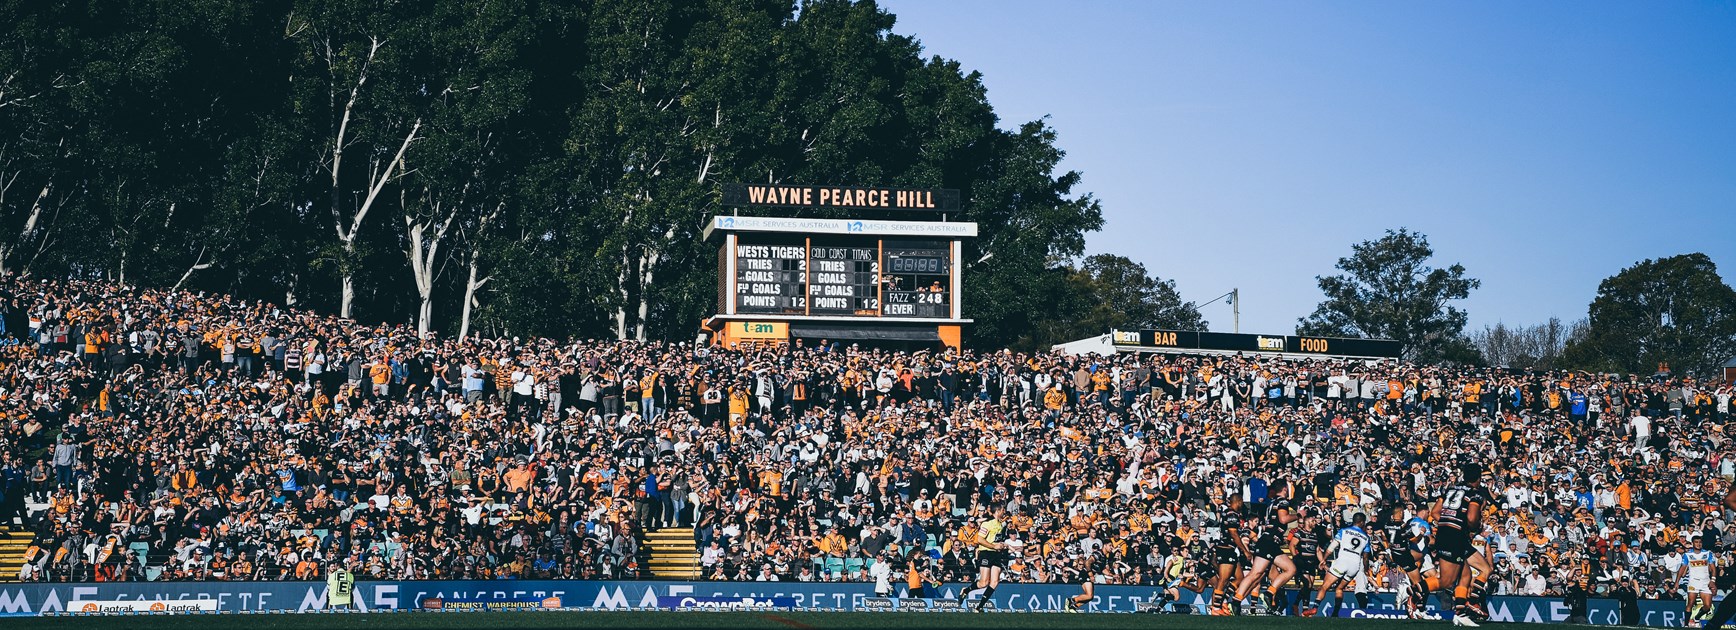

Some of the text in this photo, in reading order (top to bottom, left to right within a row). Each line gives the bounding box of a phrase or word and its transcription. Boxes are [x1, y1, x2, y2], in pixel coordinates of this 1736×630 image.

[749, 186, 935, 208] WAYNE PEARCE HILL
[737, 245, 805, 259] WESTS TIGERS
[829, 248, 847, 259] COAST
[747, 259, 805, 270] TRIES 2
[820, 261, 878, 272] TRIES 2
[745, 271, 805, 282] GOALS 2
[818, 273, 878, 284] GOALS 2
[752, 283, 780, 295] GOALS
[825, 285, 853, 296] GOALS
[743, 296, 776, 307] POINTS
[815, 298, 847, 308] POINTS
[889, 293, 909, 303] FAZZ
[884, 304, 913, 315] 4 EVER
[1154, 332, 1177, 346] BAR
[1300, 338, 1328, 352] FOOD
[1389, 530, 1396, 544] 7
[1351, 538, 1361, 550] 9
[339, 581, 348, 593] E
[865, 599, 891, 607] brydens
[900, 600, 925, 608] brydens
[934, 600, 959, 608] brydens
